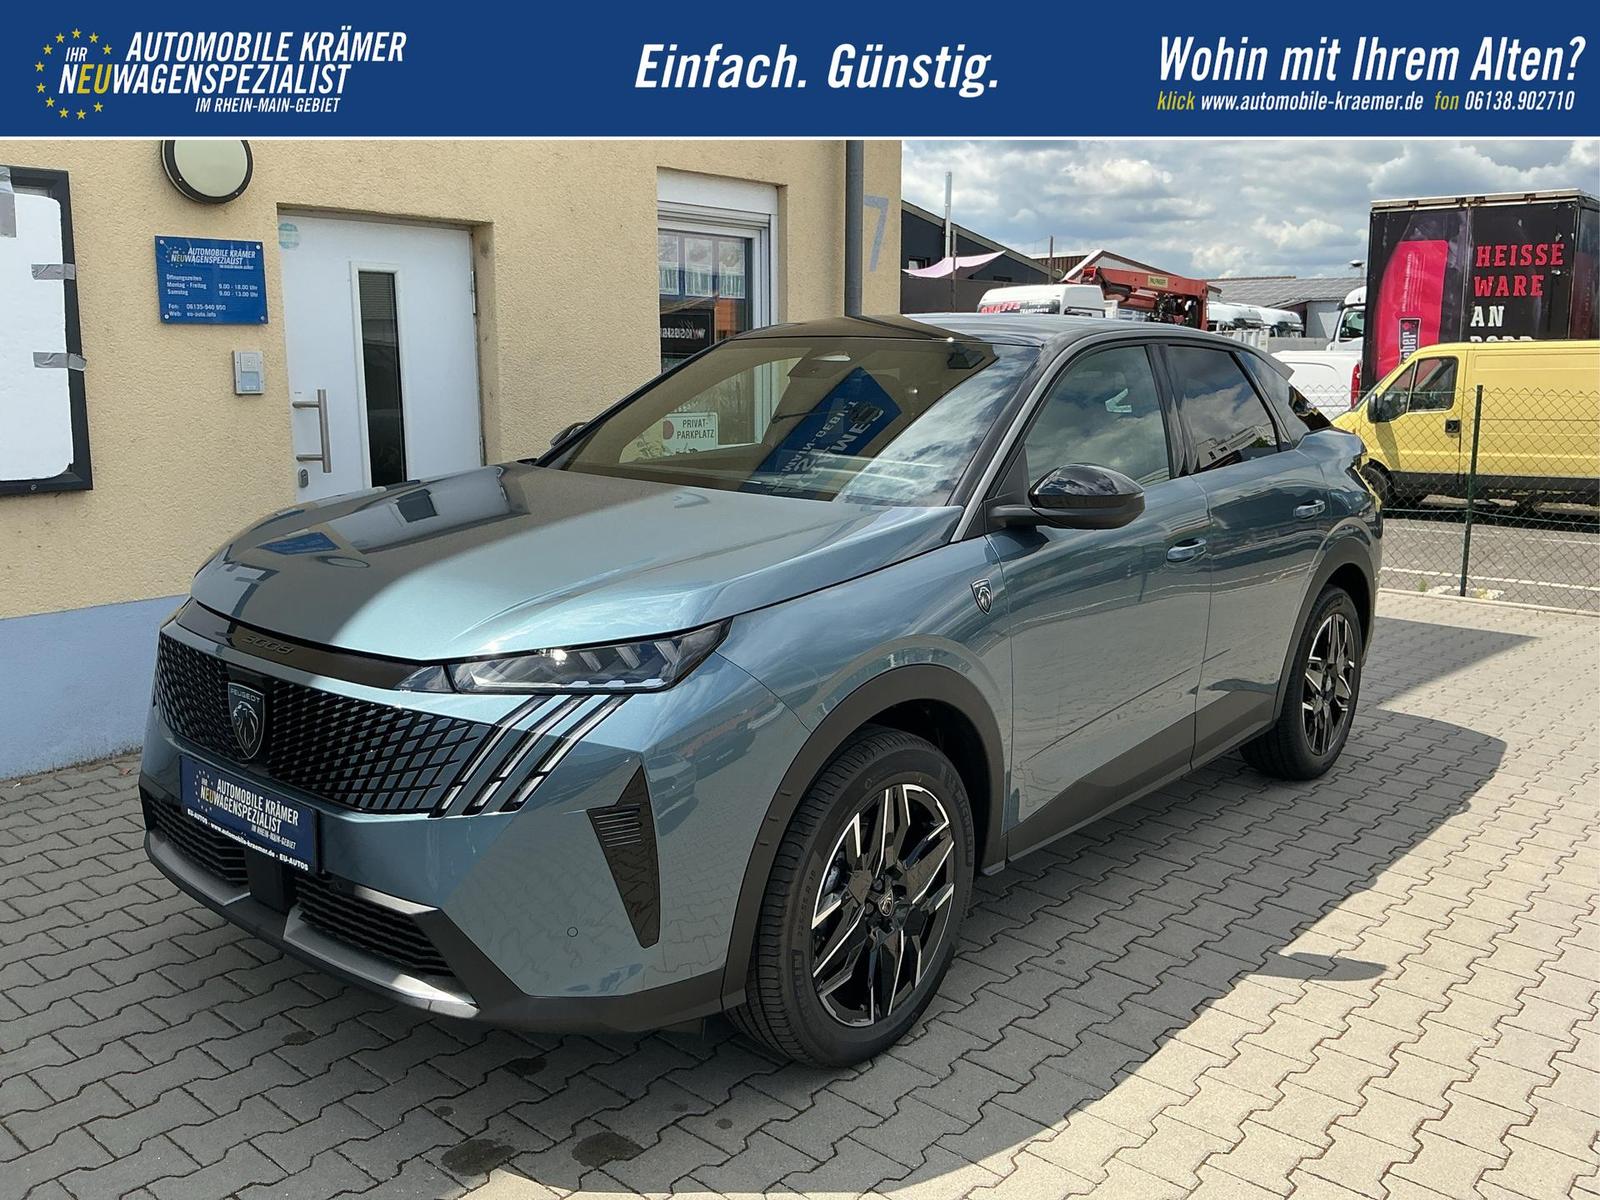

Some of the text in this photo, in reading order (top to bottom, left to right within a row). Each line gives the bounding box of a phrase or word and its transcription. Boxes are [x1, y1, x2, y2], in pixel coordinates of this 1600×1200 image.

[170, 254, 244, 265] NEUWAGENSPEZIALIST
[187, 247, 256, 259] AUTOMOBILE KRÄMER
[1475, 243, 1565, 267] HEISSE
[1473, 275, 1545, 297] WARE
[1470, 305, 1505, 327] AN
[1400, 331, 1417, 359] ber
[676, 428, 715, 440] PARKPLATZ
[682, 418, 709, 429] PRIVAT-
[230, 687, 260, 703] PEUGEOT
[200, 785, 281, 834] NEUWAGENSPEZIALIST
[216, 778, 299, 826] AUTOMOBILE KRÄMER
[210, 822, 276, 858] www.automobile-kraemer.de
[279, 853, 309, 871] EU-AUTOS
